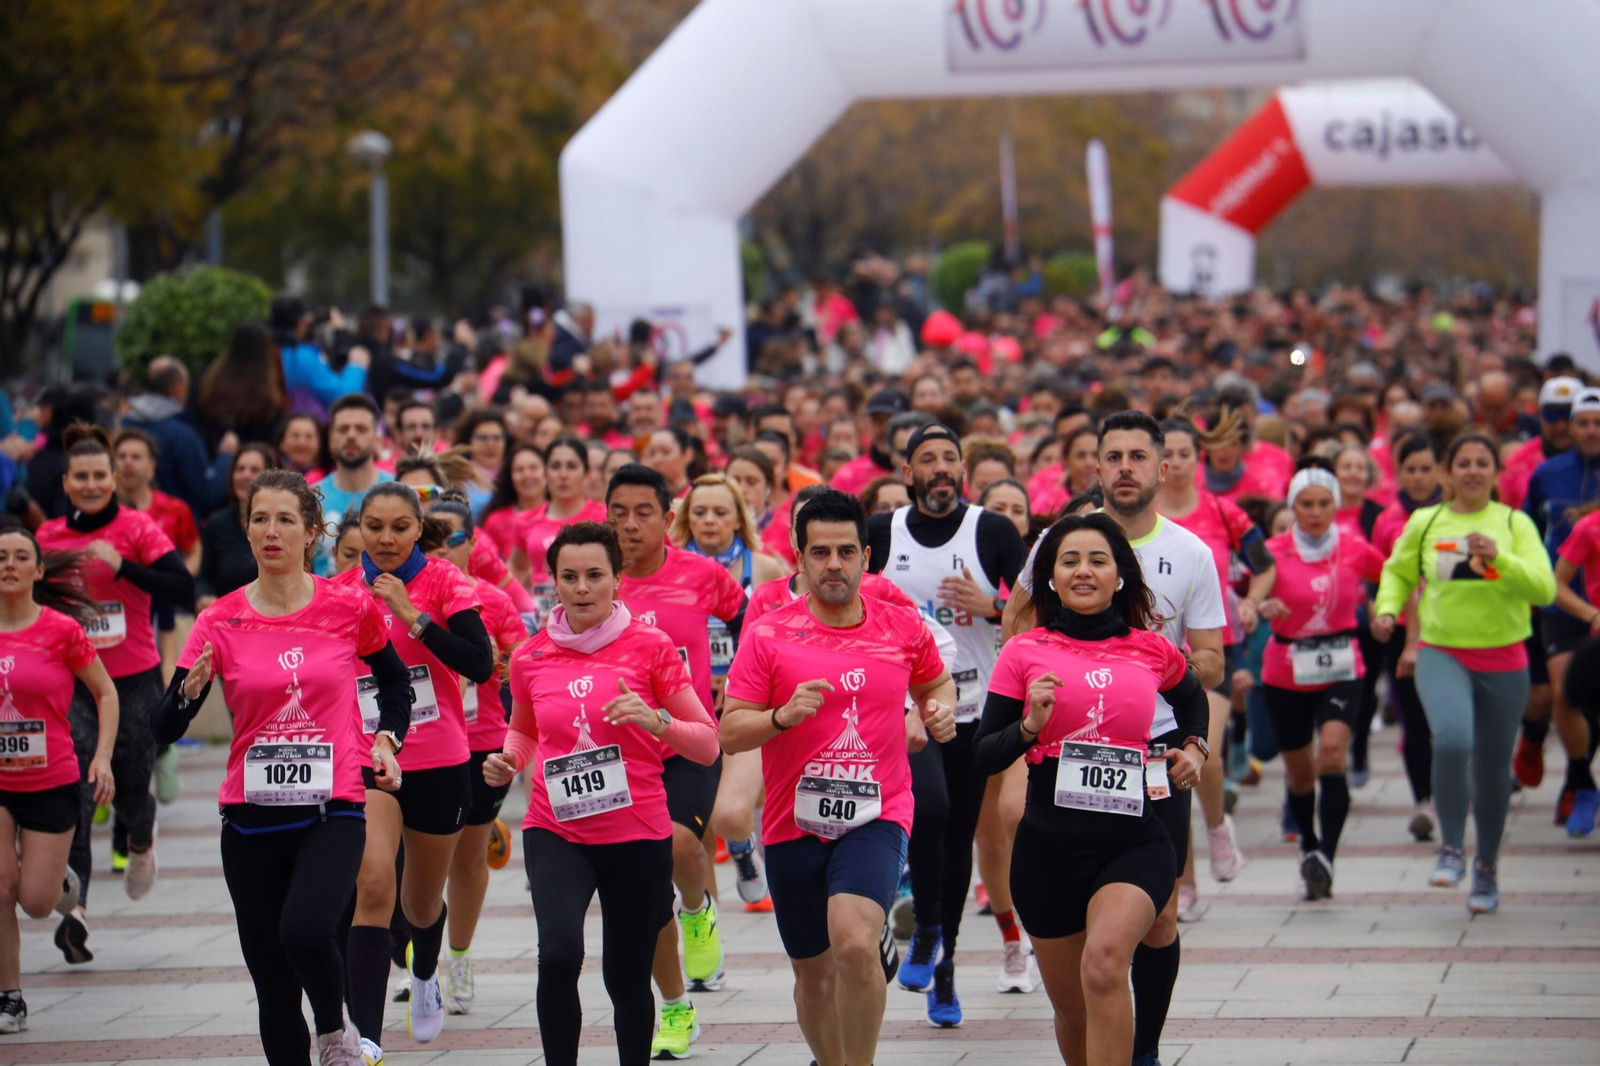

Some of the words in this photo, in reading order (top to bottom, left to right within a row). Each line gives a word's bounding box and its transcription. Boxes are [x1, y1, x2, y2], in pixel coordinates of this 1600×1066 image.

[263, 763, 312, 785] 1020
[561, 769, 605, 798] 1419
[804, 761, 876, 782] PINK
[1079, 765, 1128, 791] 1032
[818, 797, 857, 821] 640
